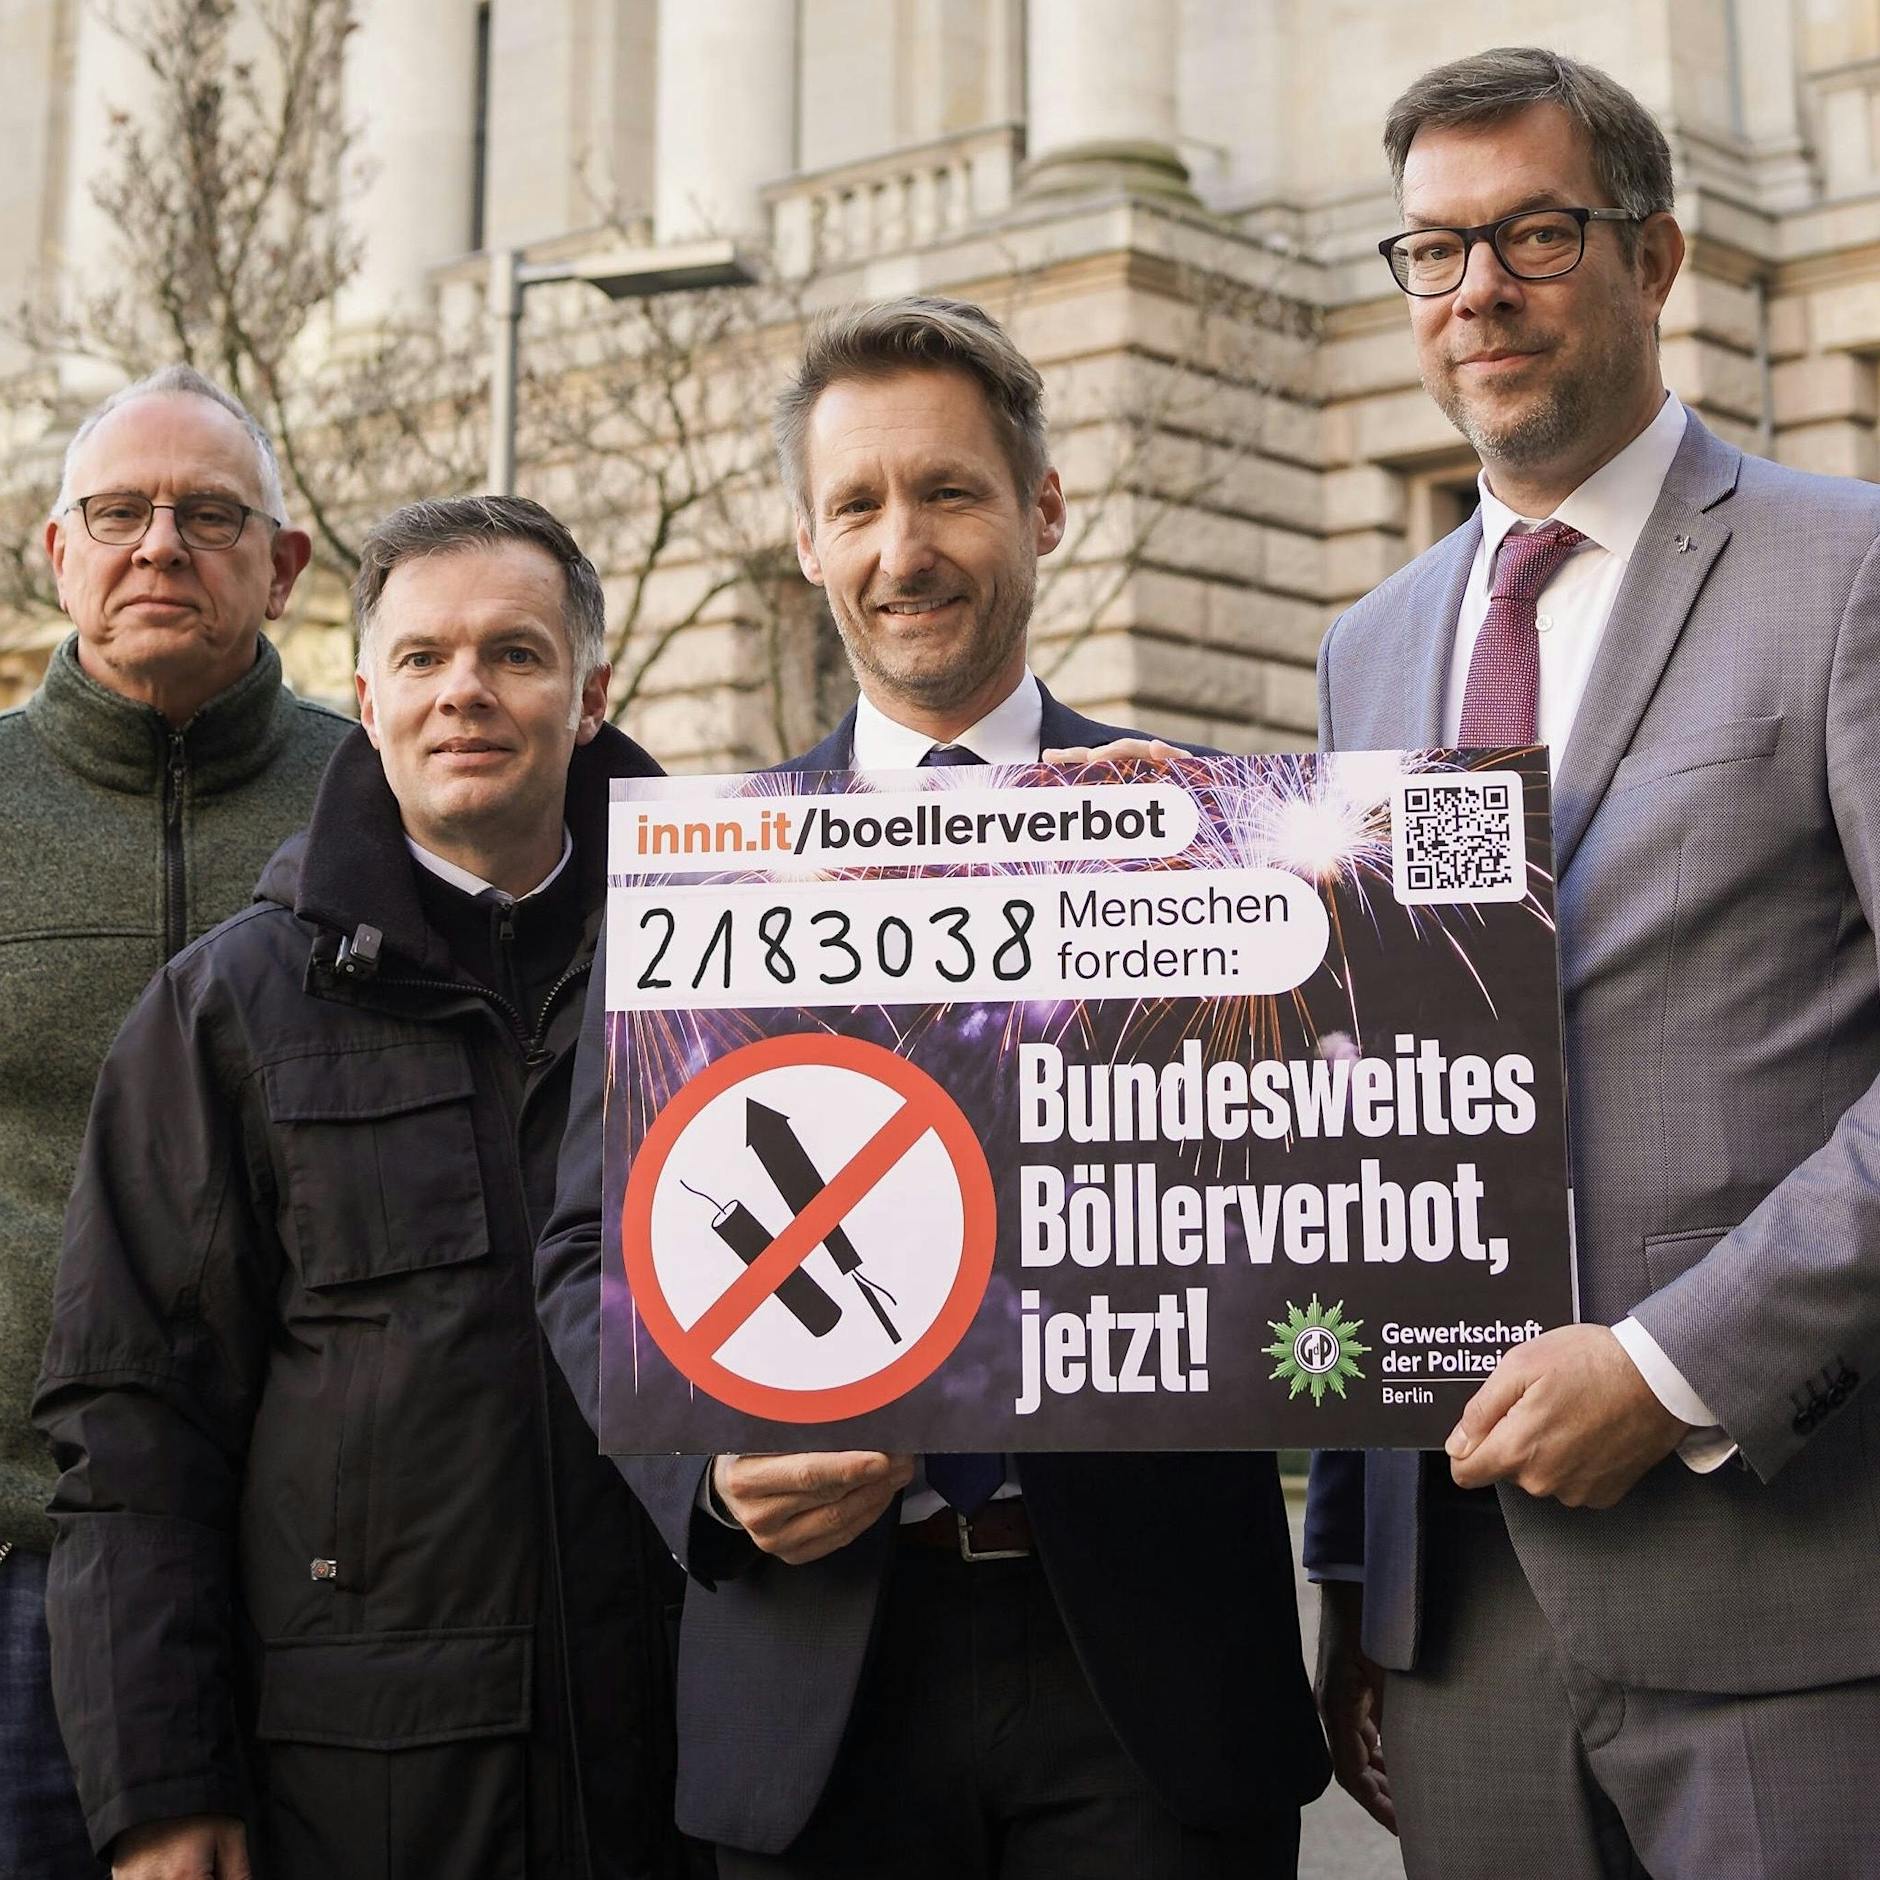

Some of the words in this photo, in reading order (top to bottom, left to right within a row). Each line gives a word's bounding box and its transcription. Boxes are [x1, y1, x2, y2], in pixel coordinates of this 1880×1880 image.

[637, 800, 1166, 855] innn.it/boellerverbot
[1059, 886, 1289, 928] Menschen
[637, 899, 1036, 990] 2183038
[1057, 939, 1239, 980] fordern:
[1018, 1033, 1536, 1143] Bundesweites
[1020, 1159, 1510, 1275] Böllerverbot,
[1015, 1287, 1210, 1415] jetzt!
[1381, 1320, 1543, 1344] Gewerkschaft
[1381, 1350, 1422, 1372] der
[1381, 1387, 1434, 1404] Berlin
